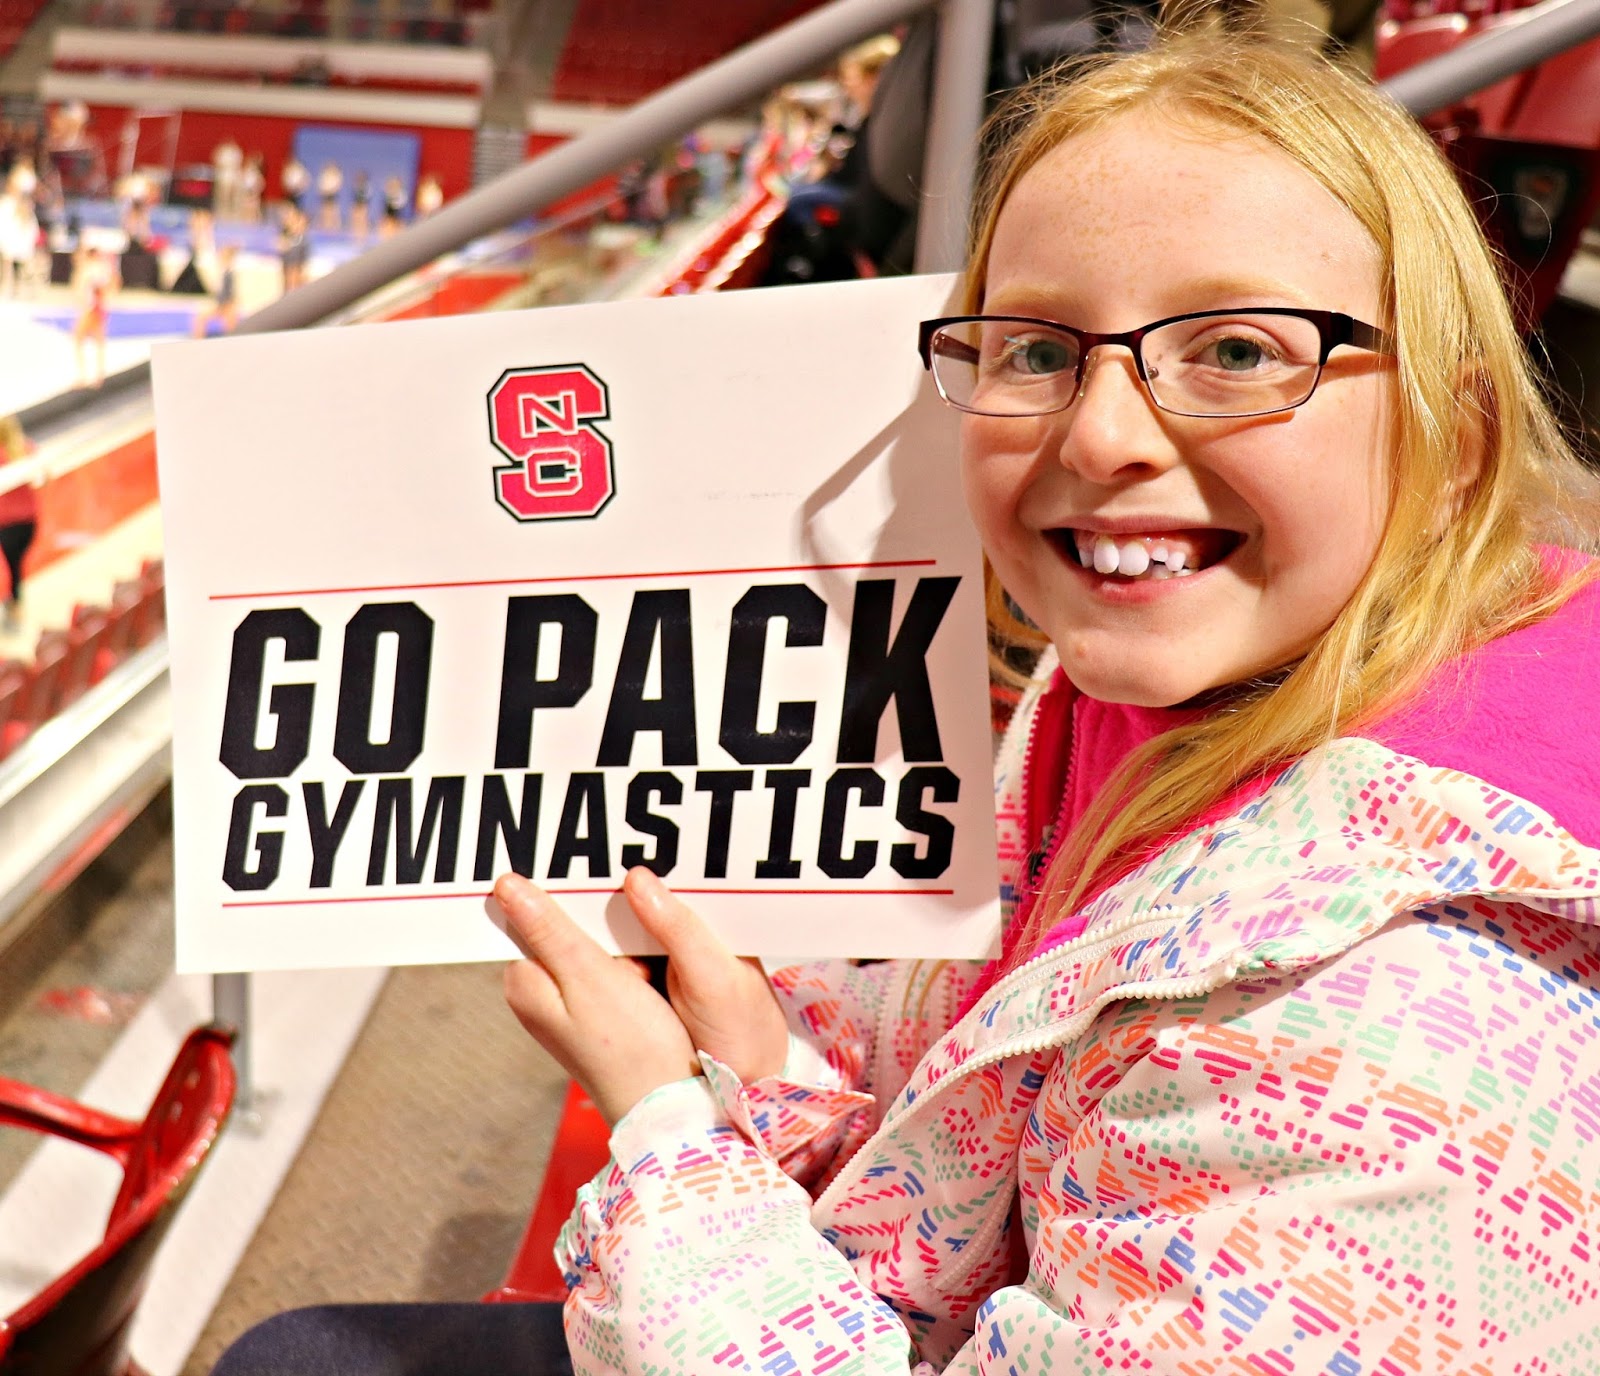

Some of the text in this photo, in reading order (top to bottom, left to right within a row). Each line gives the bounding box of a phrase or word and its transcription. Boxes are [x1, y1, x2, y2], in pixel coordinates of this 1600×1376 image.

[219, 575, 963, 780] GO PACK
[222, 765, 961, 892] GYMNASTICS
